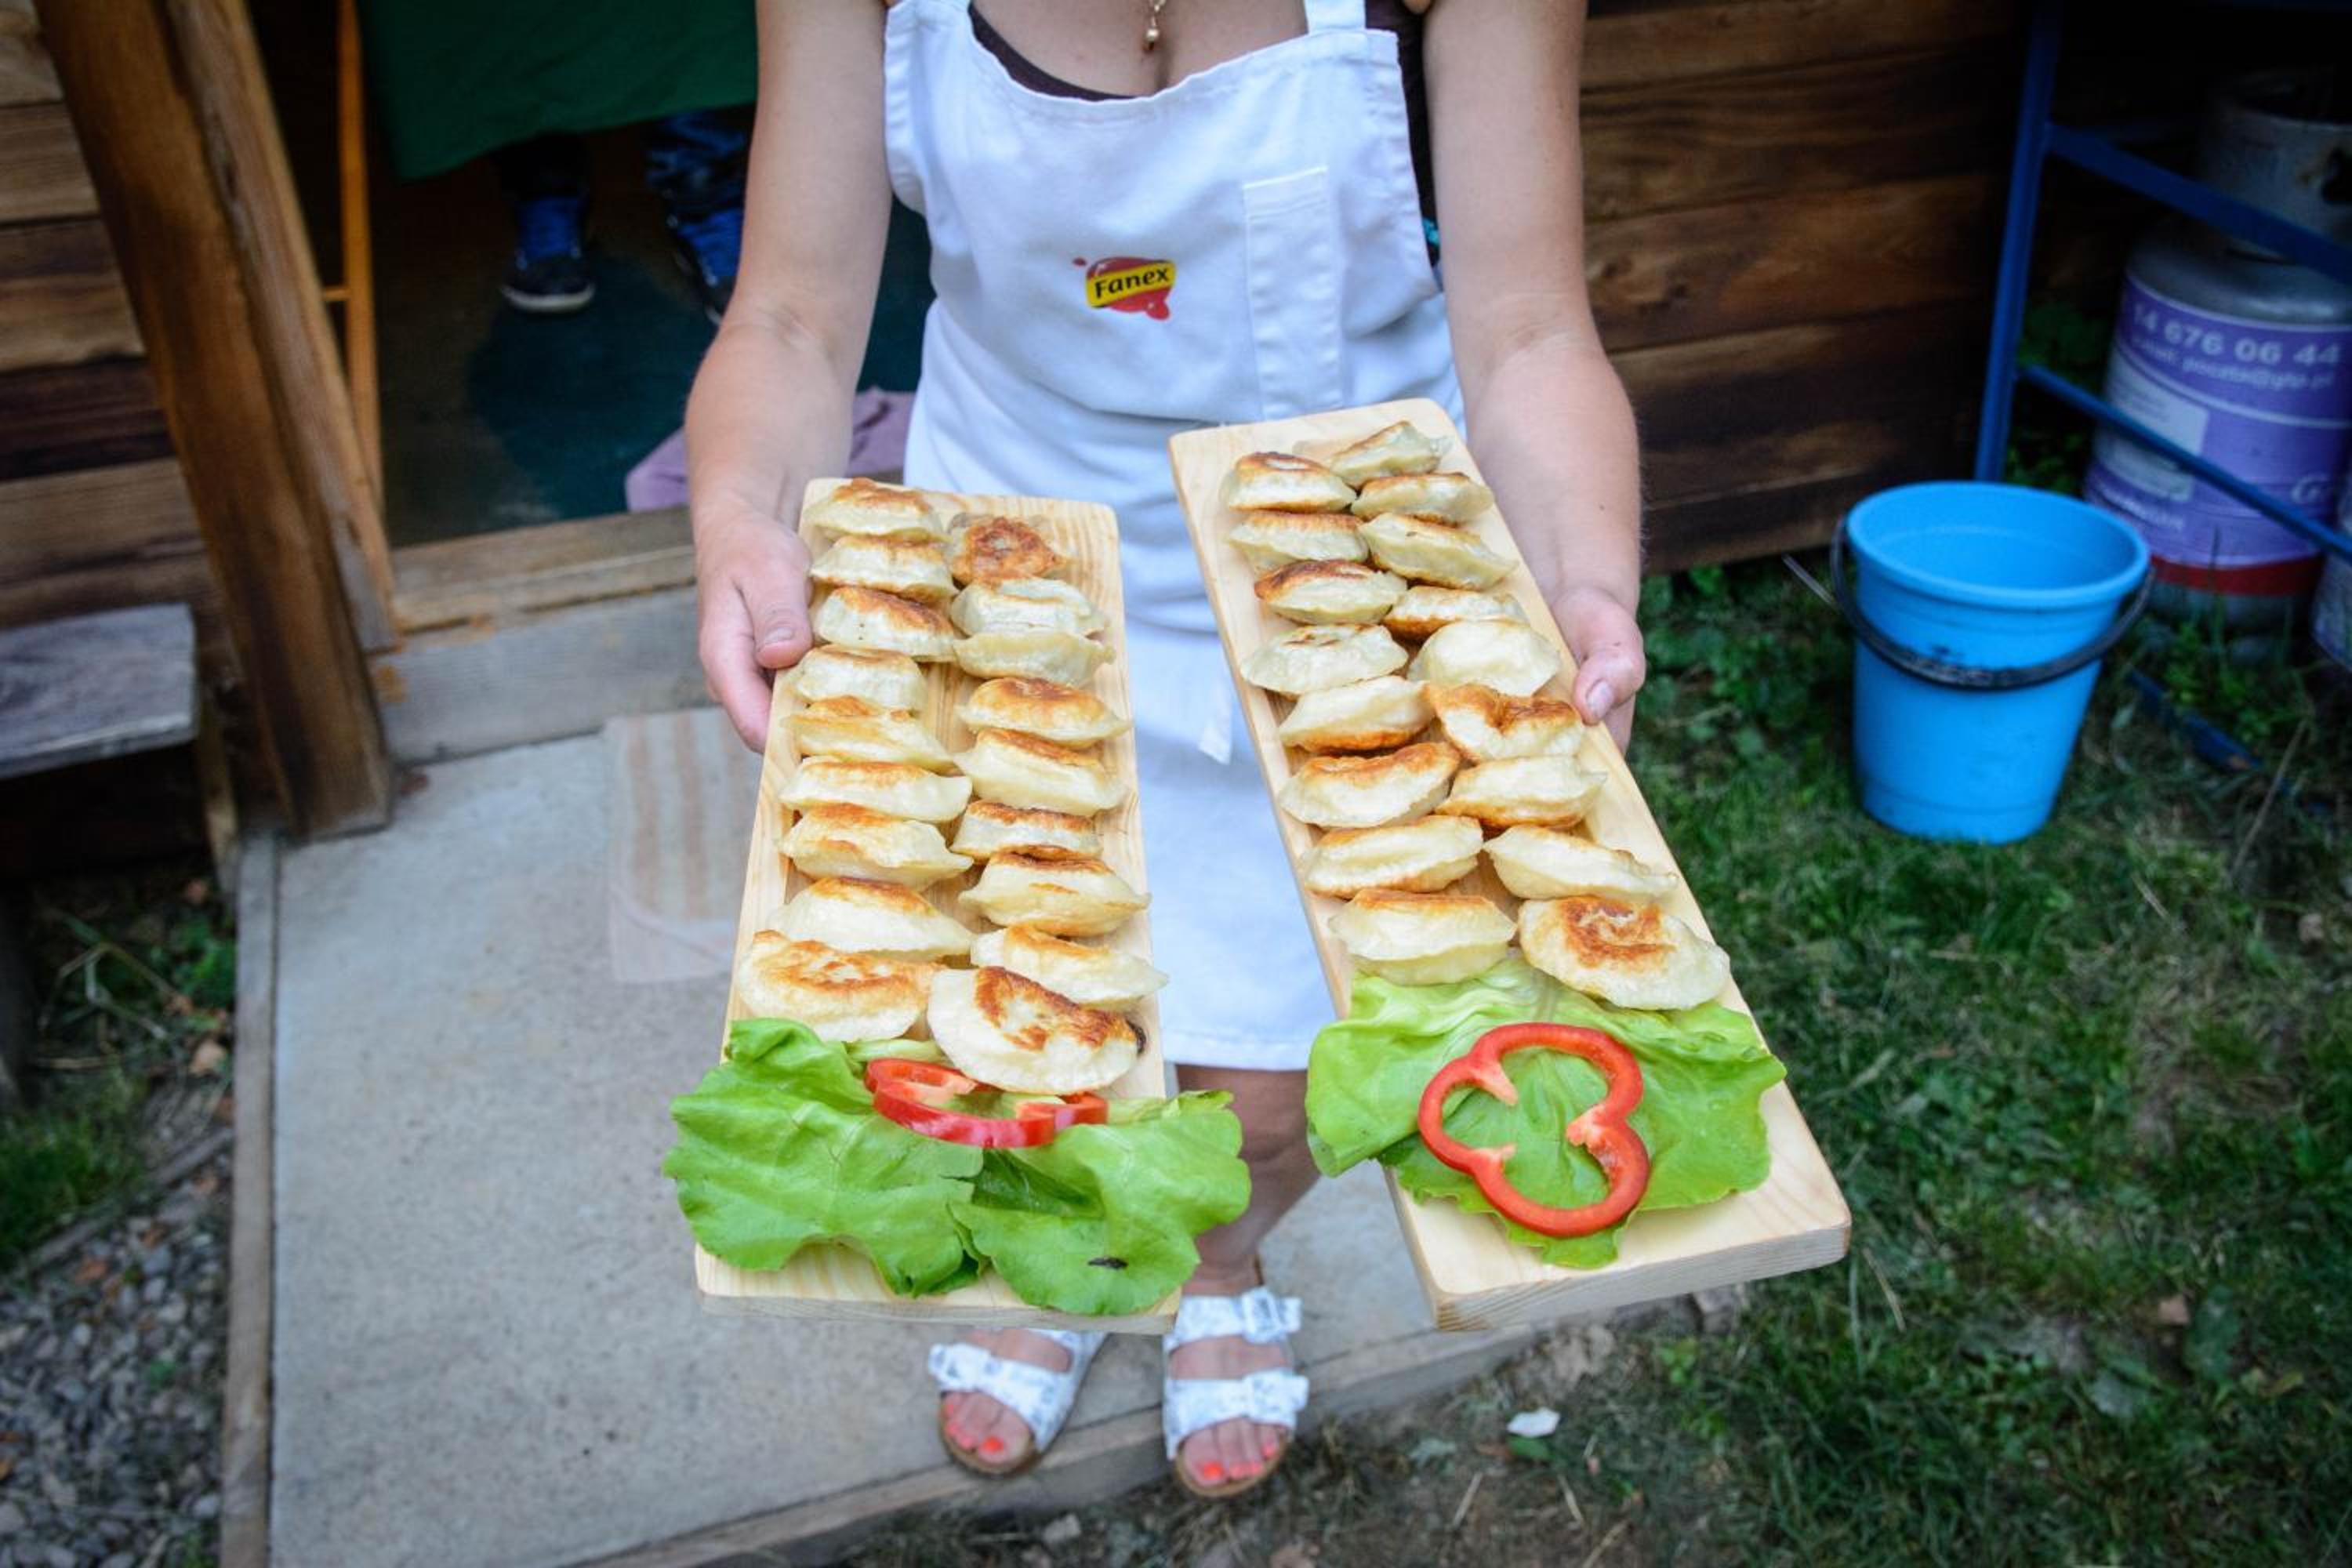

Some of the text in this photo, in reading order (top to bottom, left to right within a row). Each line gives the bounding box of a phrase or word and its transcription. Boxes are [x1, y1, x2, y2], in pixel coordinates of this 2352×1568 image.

[1094, 268, 1169, 299] Fanex
[2163, 320, 2224, 355] 676
[2234, 338, 2282, 365] 06
[2292, 343, 2340, 366] 44
